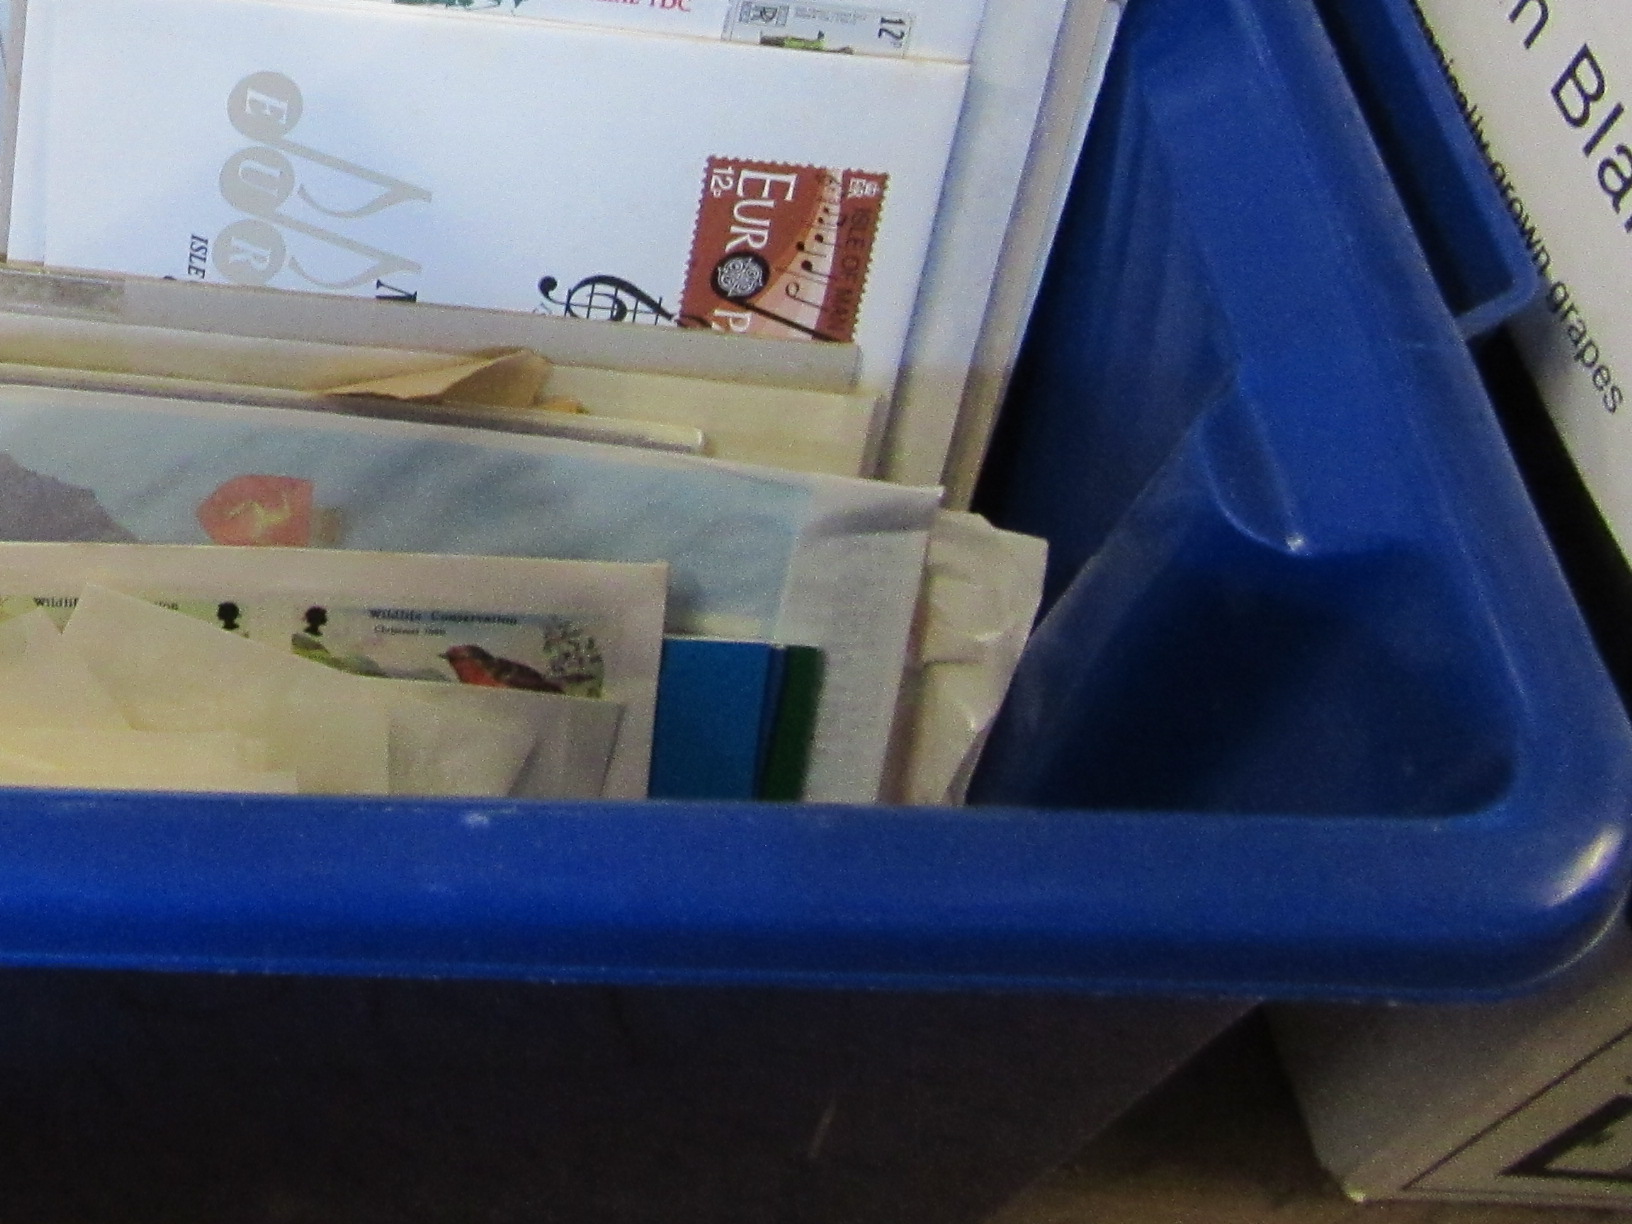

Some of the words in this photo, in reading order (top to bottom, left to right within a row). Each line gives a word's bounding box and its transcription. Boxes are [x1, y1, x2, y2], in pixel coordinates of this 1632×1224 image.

[1551, 43, 1632, 234] Bla
[186, 234, 210, 279] ISLE
[1546, 280, 1626, 415] grapes
